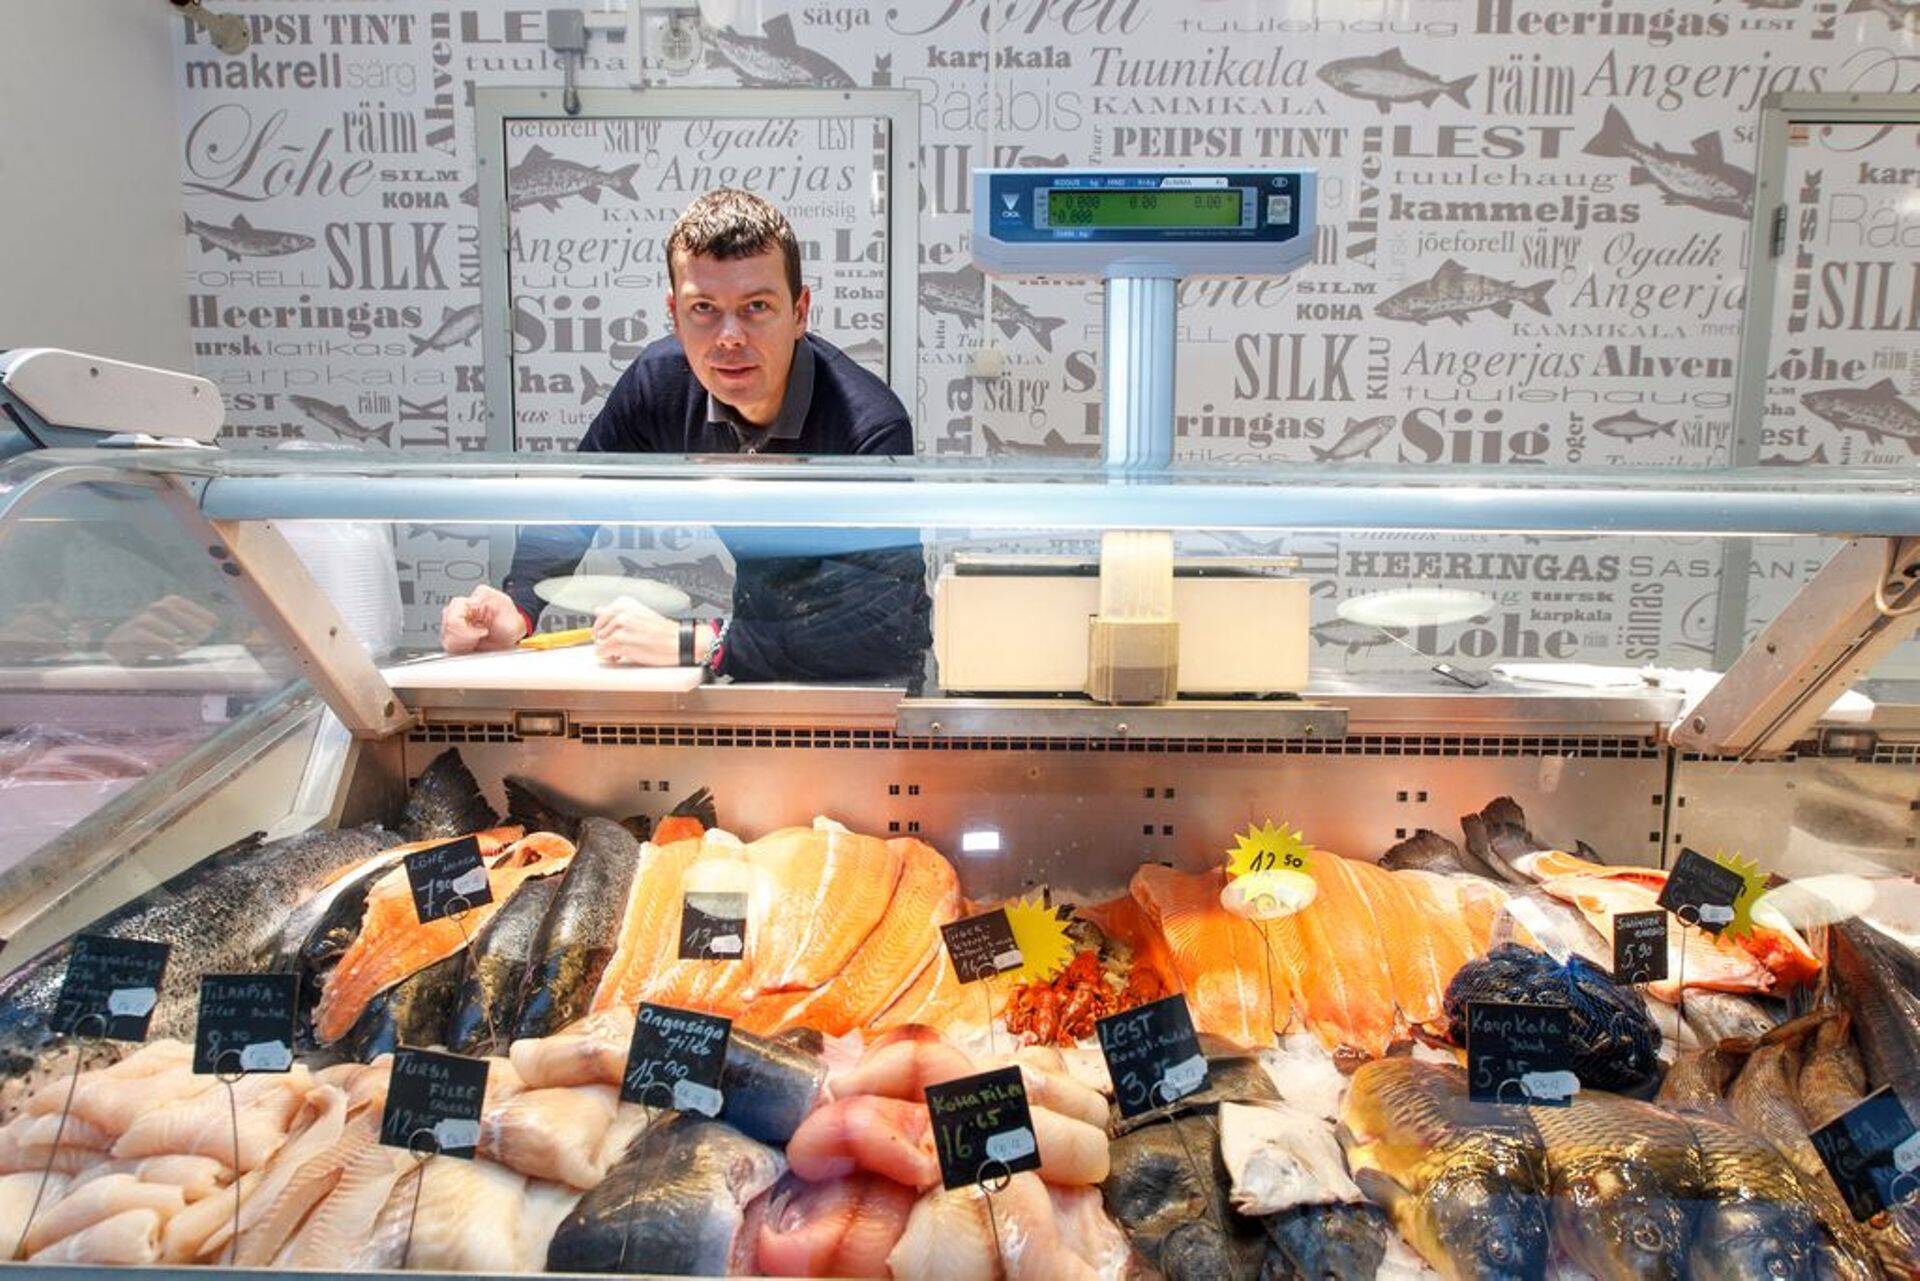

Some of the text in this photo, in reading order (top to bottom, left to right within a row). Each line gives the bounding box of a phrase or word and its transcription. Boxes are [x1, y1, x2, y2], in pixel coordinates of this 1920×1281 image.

[184, 14, 416, 45] PPSI TINT
[1474, 0, 1728, 46] Heeringas
[185, 53, 341, 89] makrell
[425, 11, 457, 157] Ahven
[1092, 46, 1309, 87] Tuunikala
[1484, 54, 1575, 116] räim
[342, 101, 418, 153] räim
[1093, 97, 1328, 114] KAMMKALA
[182, 104, 375, 201] Lõhe
[1112, 126, 1349, 158] PEIPSI TINT
[1392, 125, 1575, 158] LEST
[379, 169, 460, 182] SILM
[382, 192, 450, 209] KOHA
[1346, 126, 1383, 270] Ahven
[1388, 193, 1641, 230] kammeljas
[324, 221, 449, 291] SILK
[460, 224, 480, 288] KILU
[1417, 231, 1515, 256] jõeforell
[1602, 231, 1723, 279] Ogalik
[1296, 282, 1378, 294] SILM
[188, 294, 422, 338] Heeringas
[1296, 303, 1363, 321] KOHA
[1234, 332, 1359, 401] SILK
[1366, 336, 1391, 400] KILU
[1402, 340, 1586, 386] Angerjas
[1593, 345, 1733, 379] Ahven
[983, 371, 1049, 430] särg
[1345, 551, 1621, 582] HEERINGAS
[1410, 612, 1579, 658] Lõhe
[1530, 608, 1613, 624] karpkala
[1615, 582, 1665, 660] säinas
